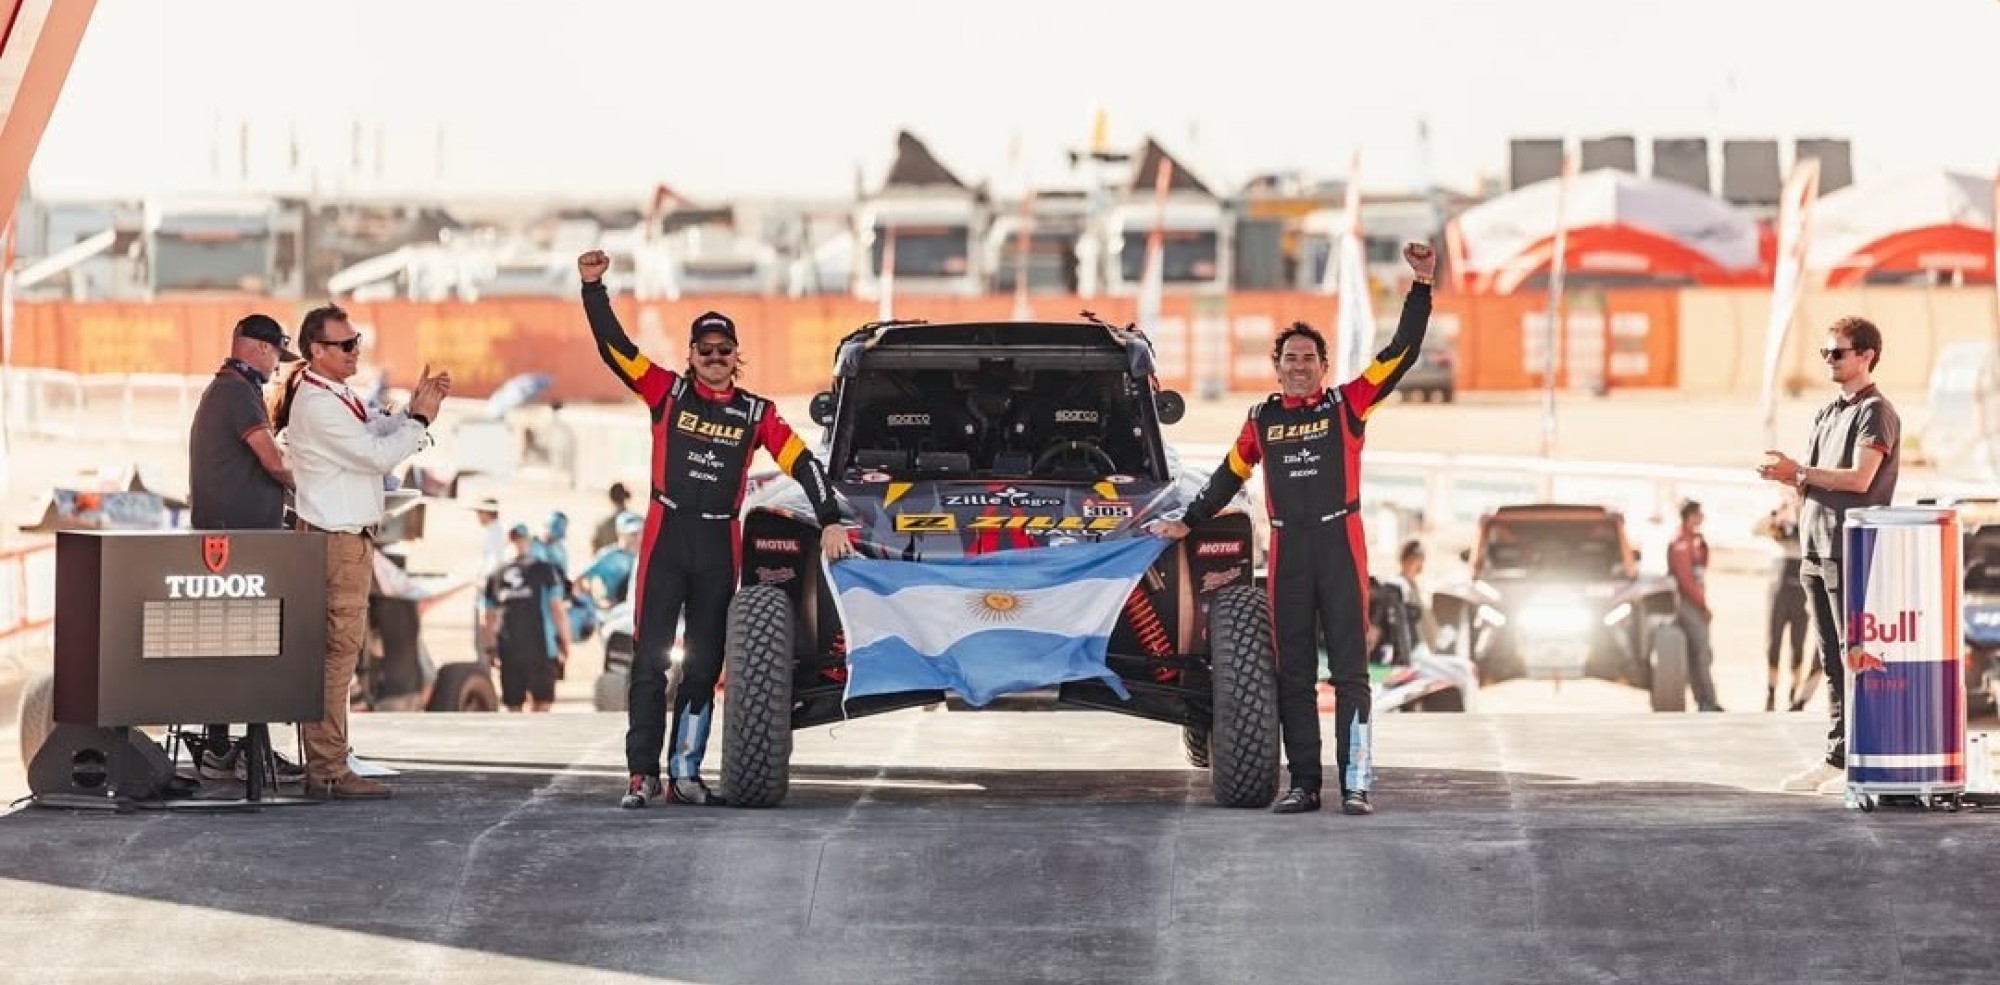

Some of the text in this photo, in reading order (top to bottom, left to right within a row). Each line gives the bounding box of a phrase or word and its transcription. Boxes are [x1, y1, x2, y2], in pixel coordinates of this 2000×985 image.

[888, 414, 930, 425] sparco
[1055, 410, 1098, 421] sparco
[697, 421, 744, 440] ZILLE
[1285, 418, 1329, 437] ZILLE
[945, 494, 1061, 508] Zille agro
[1084, 505, 1131, 517] 305
[966, 516, 1125, 529] ZILLE
[756, 539, 799, 551] MOTUL
[1198, 542, 1241, 553] MOTUL
[165, 573, 266, 598] TUDOR
[1861, 610, 1916, 643] Bull
